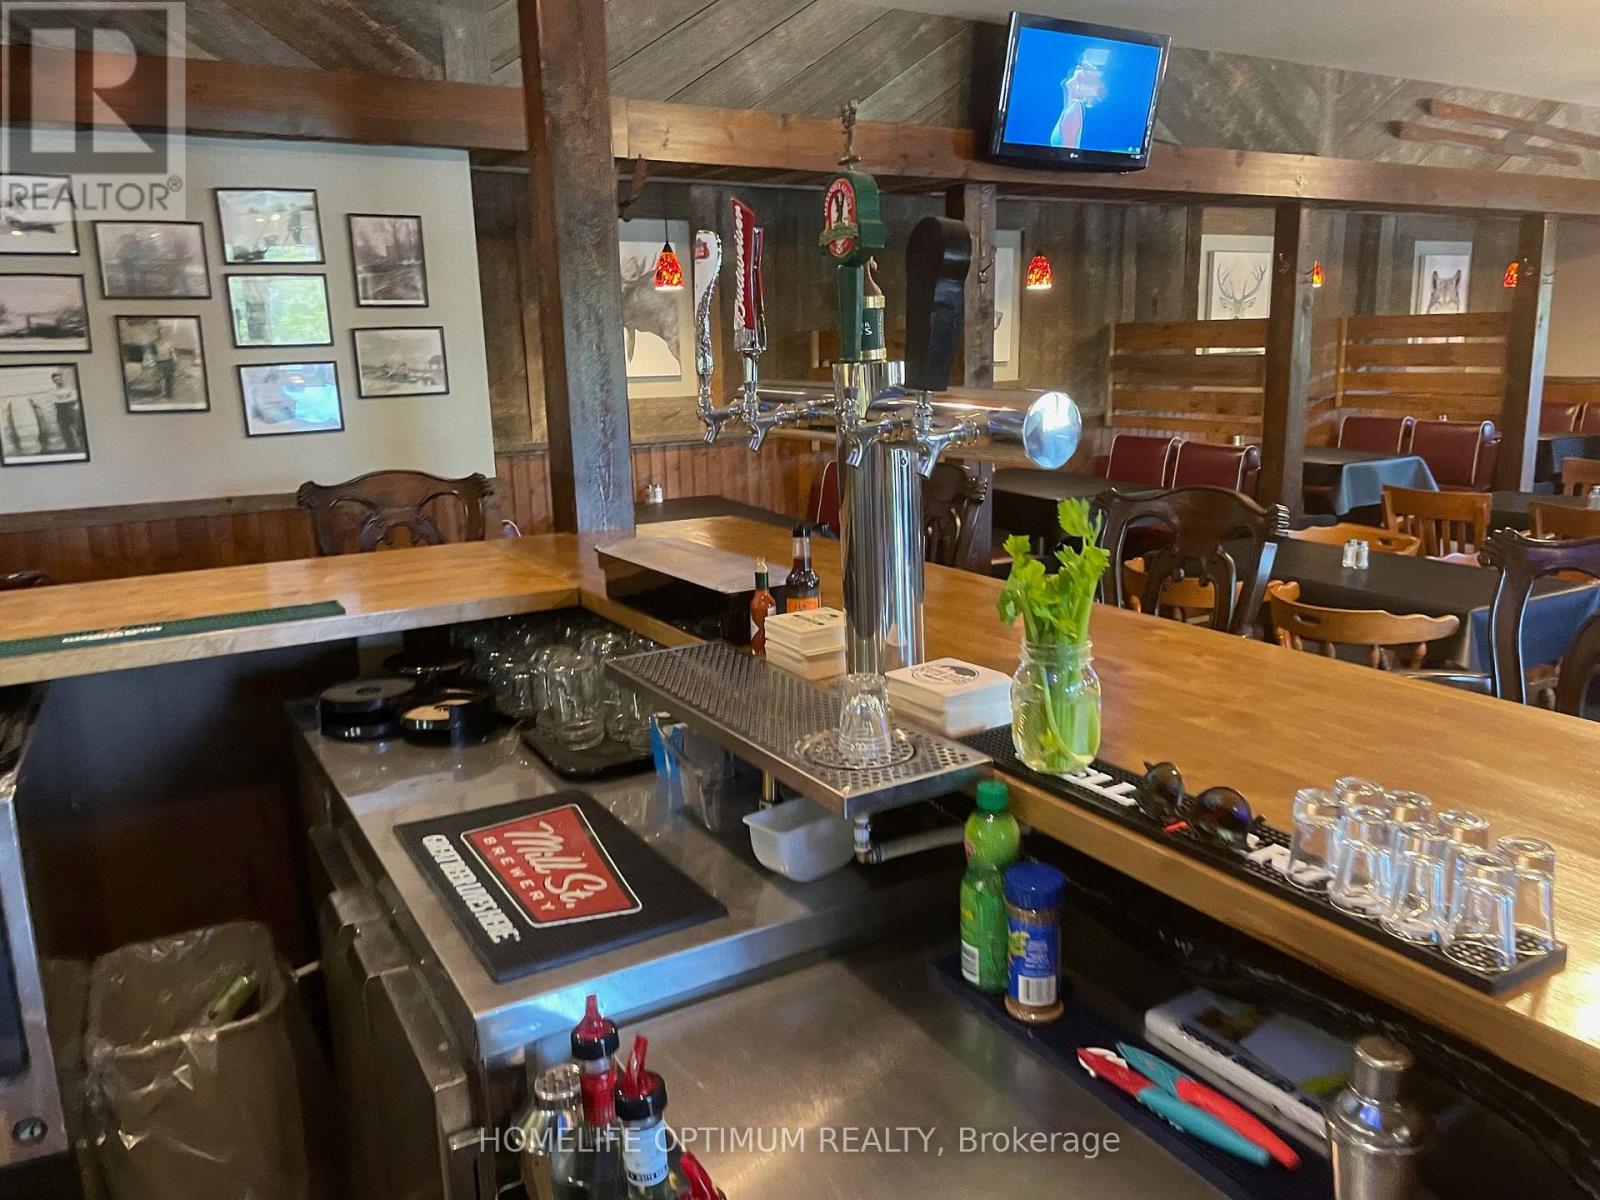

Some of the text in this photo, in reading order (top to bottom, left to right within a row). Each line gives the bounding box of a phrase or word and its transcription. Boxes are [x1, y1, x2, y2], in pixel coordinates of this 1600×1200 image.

[733, 204, 746, 326] Budweiser
[483, 836, 556, 910] BREWERY
[503, 820, 588, 874] Mill
